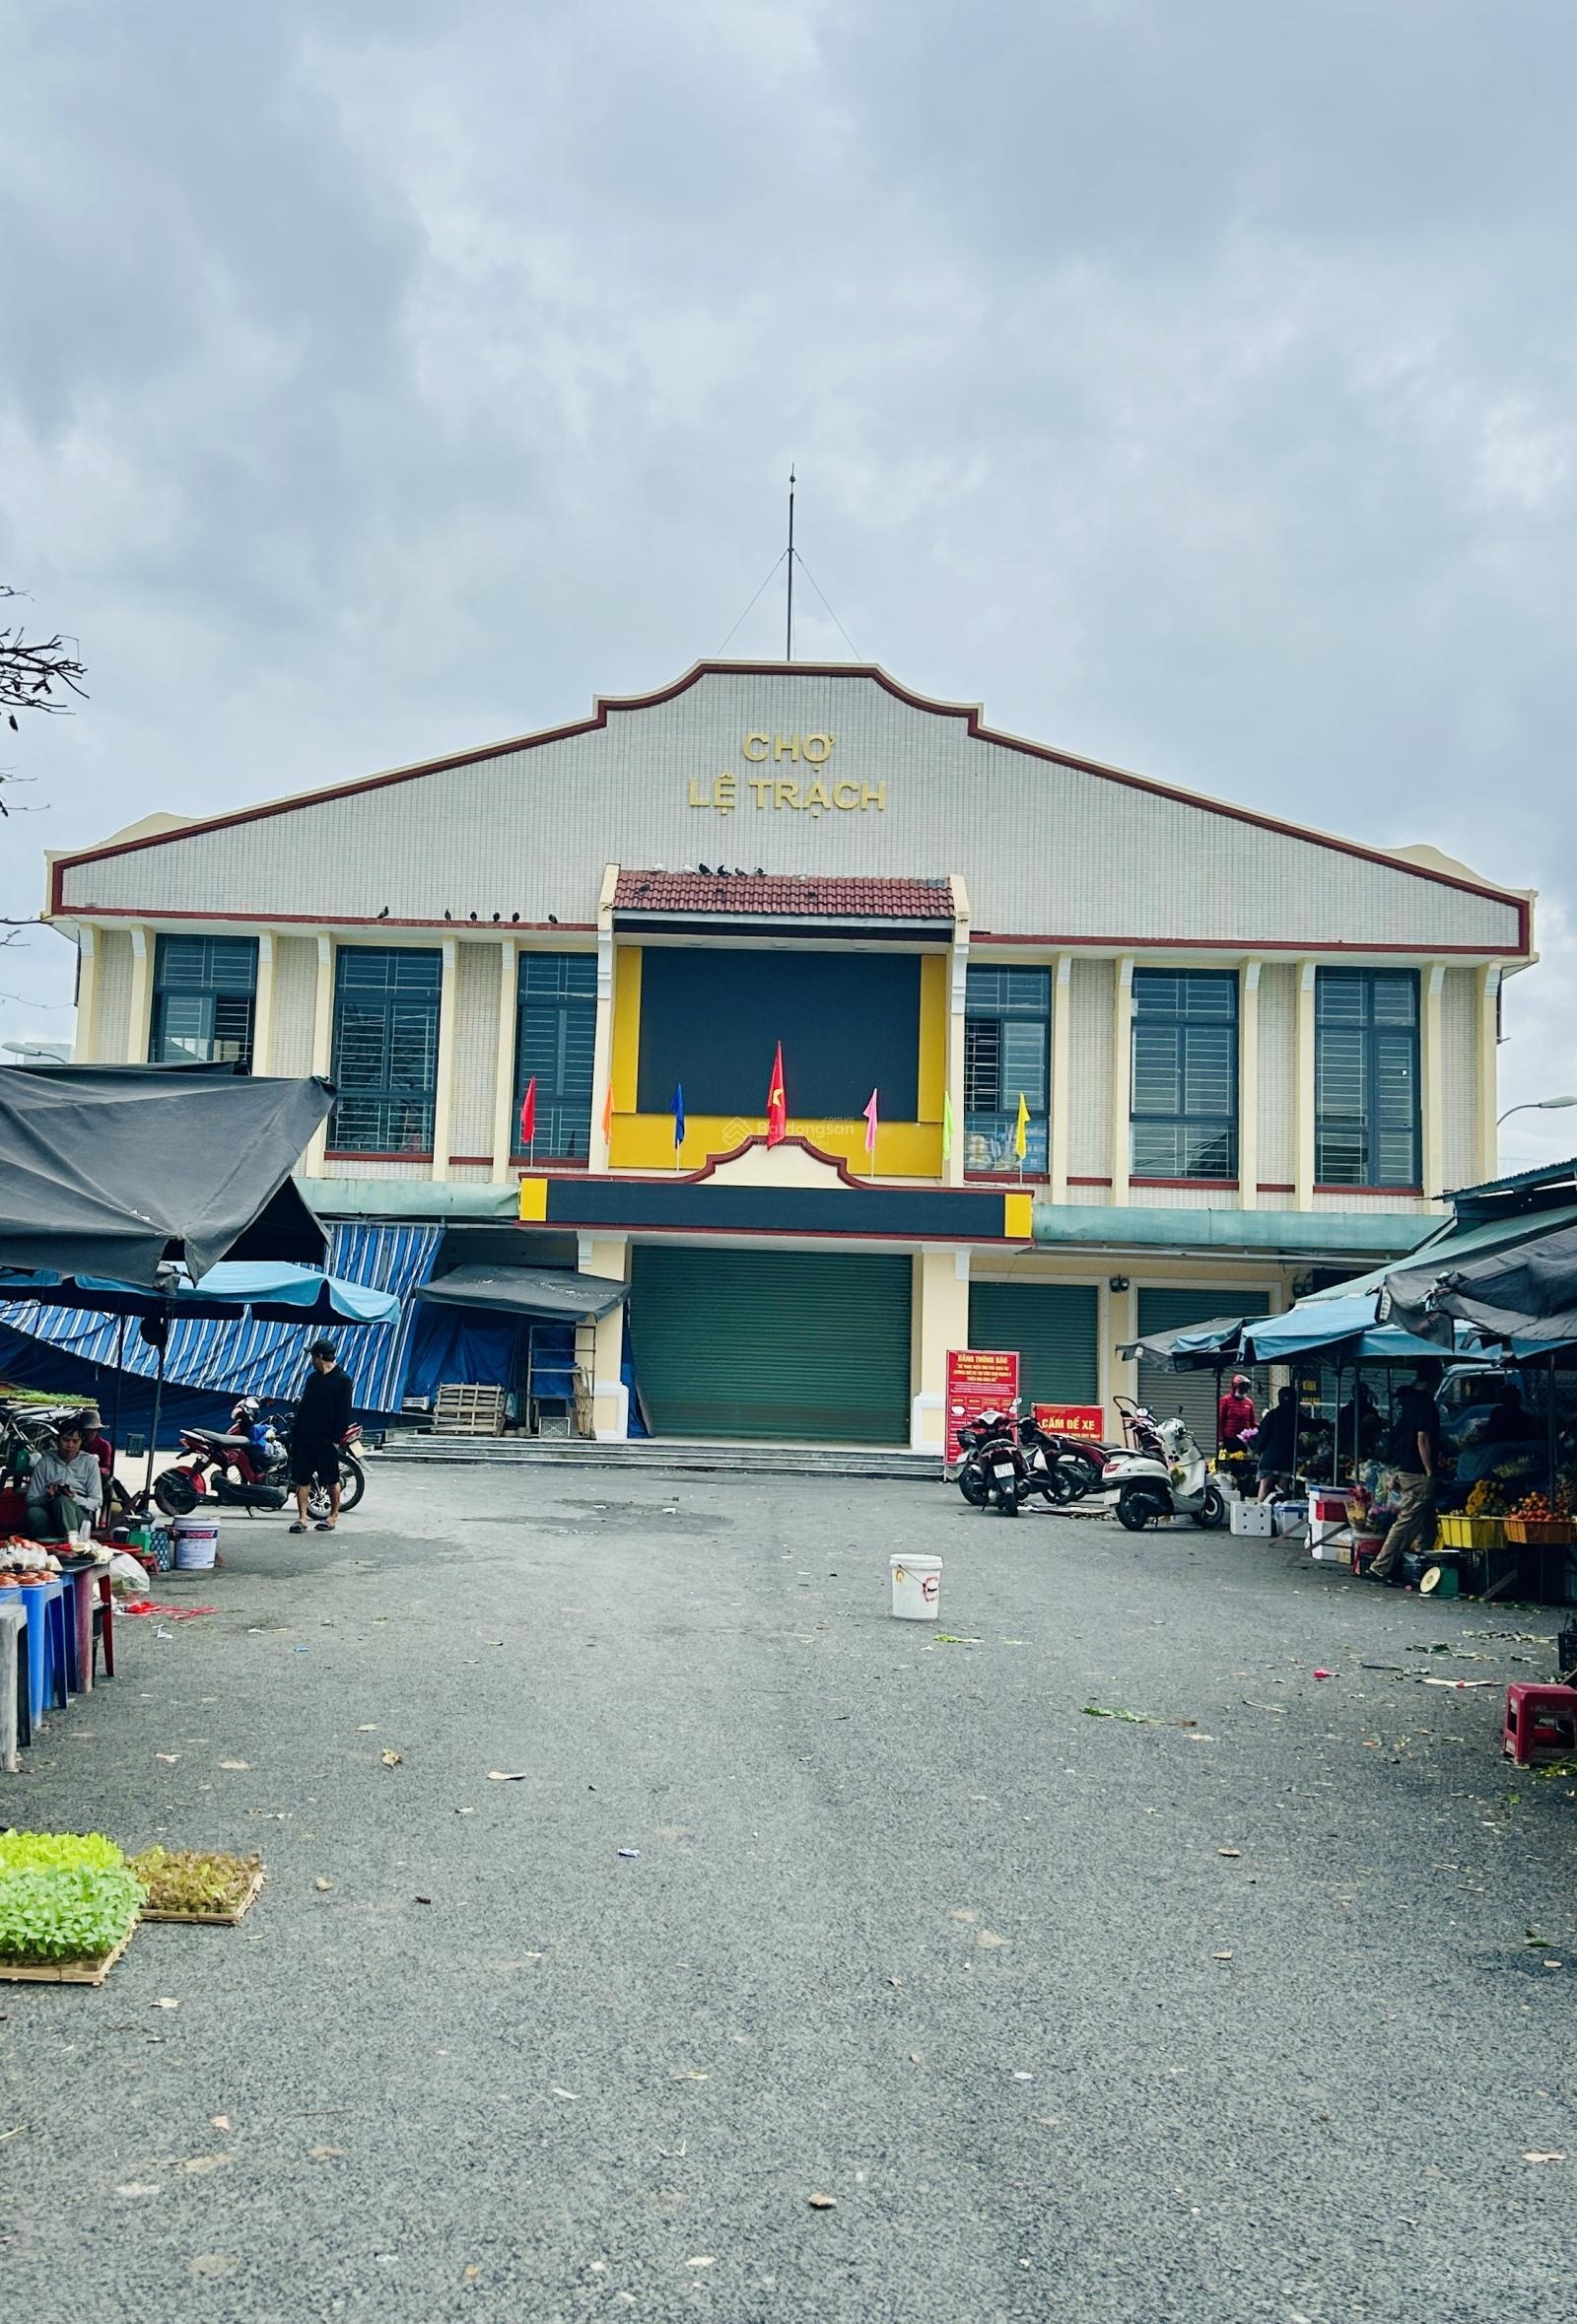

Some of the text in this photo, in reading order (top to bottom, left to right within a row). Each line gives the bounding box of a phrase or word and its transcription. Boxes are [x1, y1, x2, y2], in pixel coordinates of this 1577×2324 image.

[743, 731, 836, 772] CHỢ
[688, 772, 886, 818] LỆ TRẠCH
[1041, 1415, 1064, 1429] CẤM
[1081, 1419, 1095, 1430] XE
